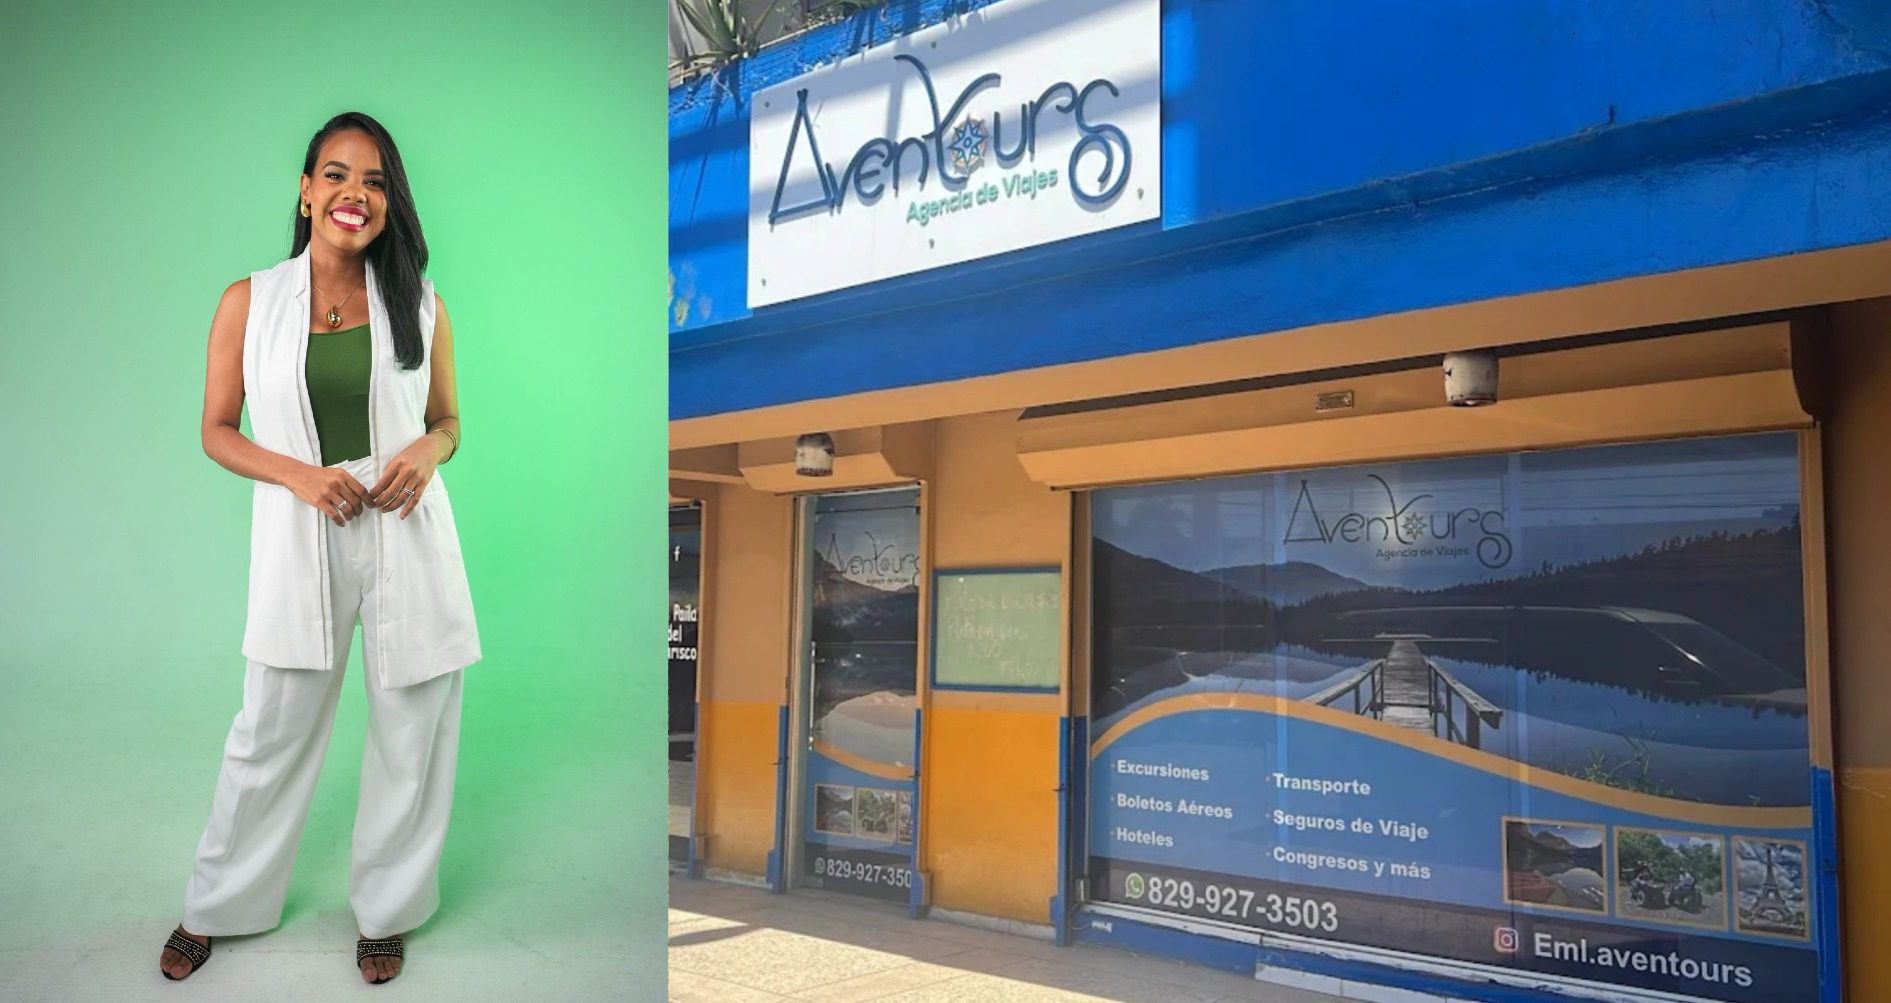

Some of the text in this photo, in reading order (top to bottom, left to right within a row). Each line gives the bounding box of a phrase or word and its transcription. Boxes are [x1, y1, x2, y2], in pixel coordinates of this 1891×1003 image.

[768, 54, 1132, 224] Aventours
[906, 169, 1058, 226] Agencia de Viajes
[1283, 473, 1512, 569] Aventours
[1375, 546, 1470, 561] Agencia de Viajes
[673, 603, 698, 621] Paila
[1117, 759, 1210, 780] Excursiones
[1272, 772, 1371, 796] Transporte
[1117, 793, 1233, 819] Boletos Aéreos
[1117, 827, 1174, 847] Hoteles
[1273, 809, 1429, 842] Seguros de Viaje
[827, 858, 912, 888] 829-927-350
[1273, 846, 1431, 880] Congresos y más
[1148, 876, 1339, 932] 829-927-3503
[1534, 932, 1753, 987] Eml.aventours
